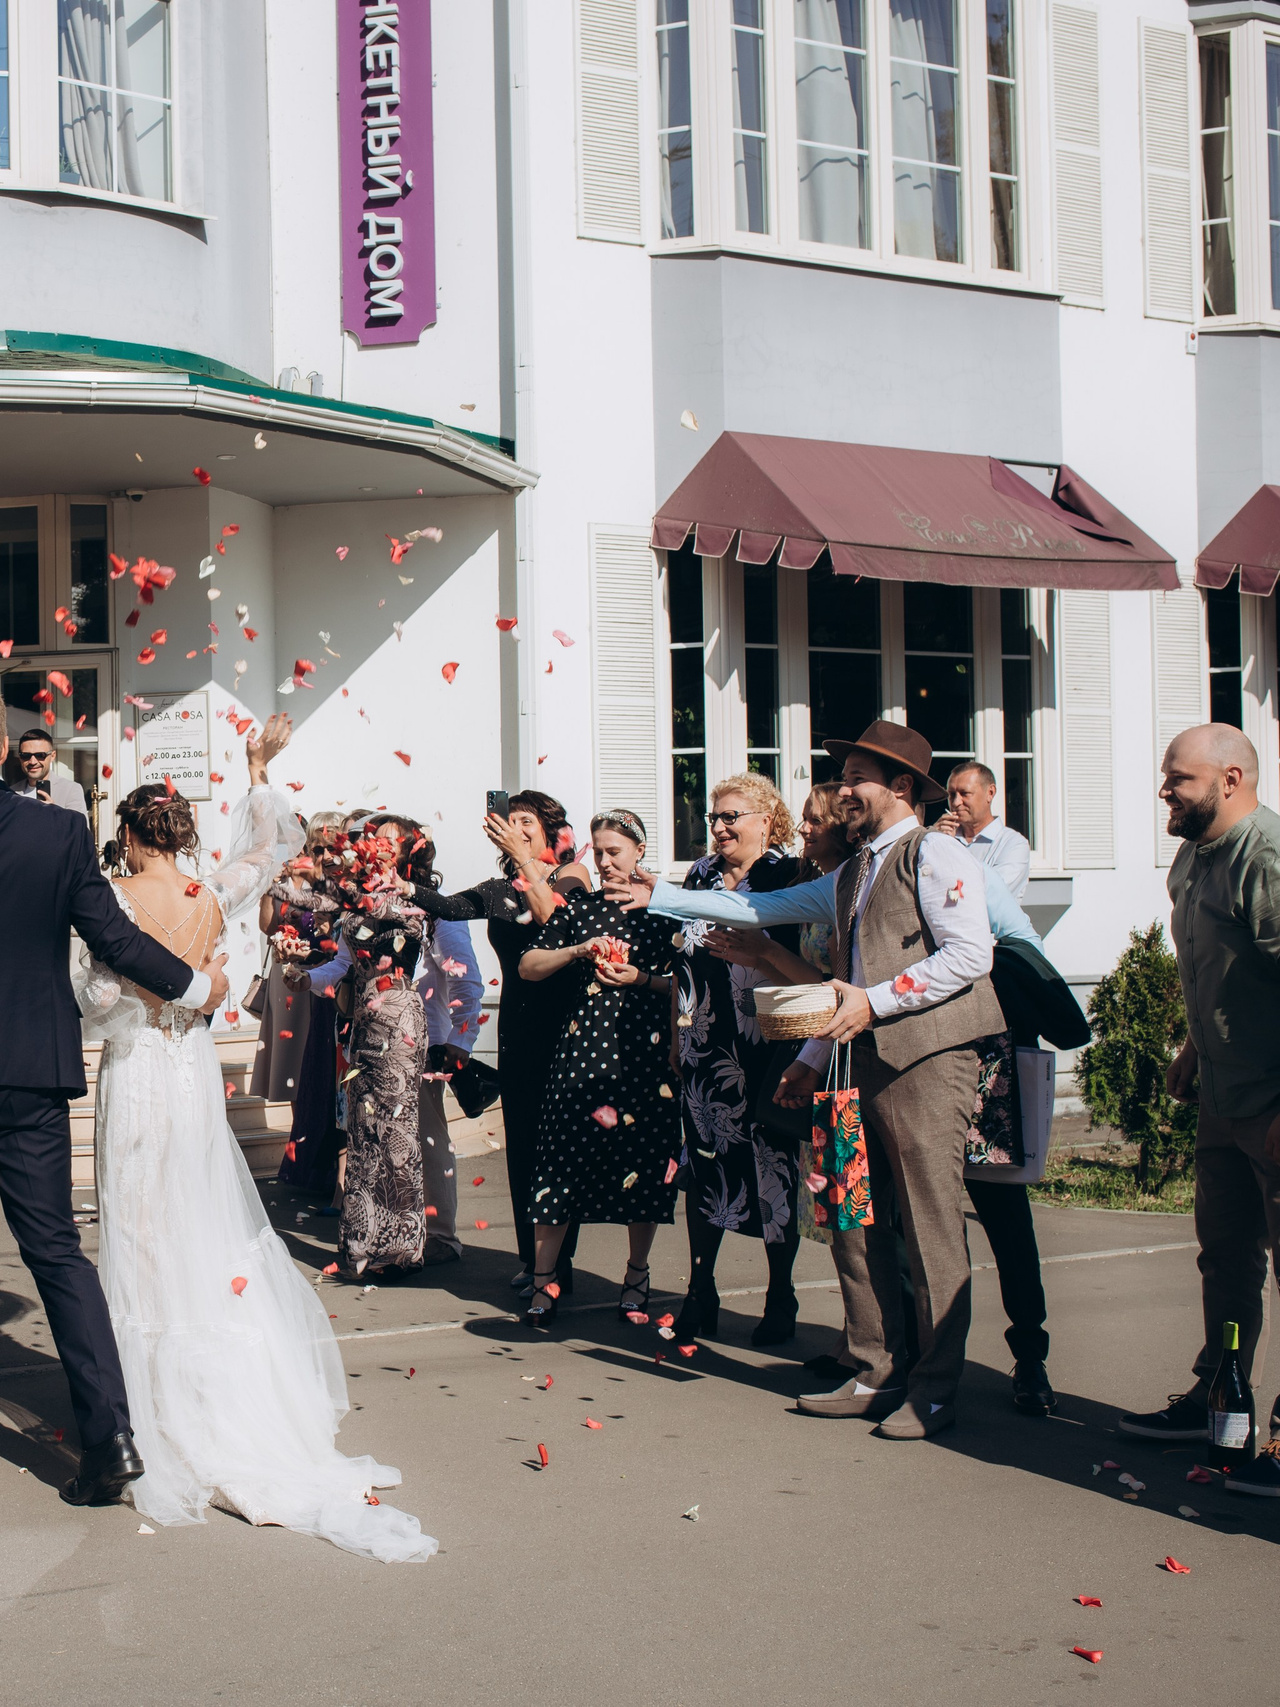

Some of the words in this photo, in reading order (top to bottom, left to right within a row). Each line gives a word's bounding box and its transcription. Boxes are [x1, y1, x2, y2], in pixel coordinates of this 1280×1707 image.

[363, 212, 404, 318] ДОМ
[141, 711, 171, 722] CASA
[175, 710, 204, 722] ROSA
